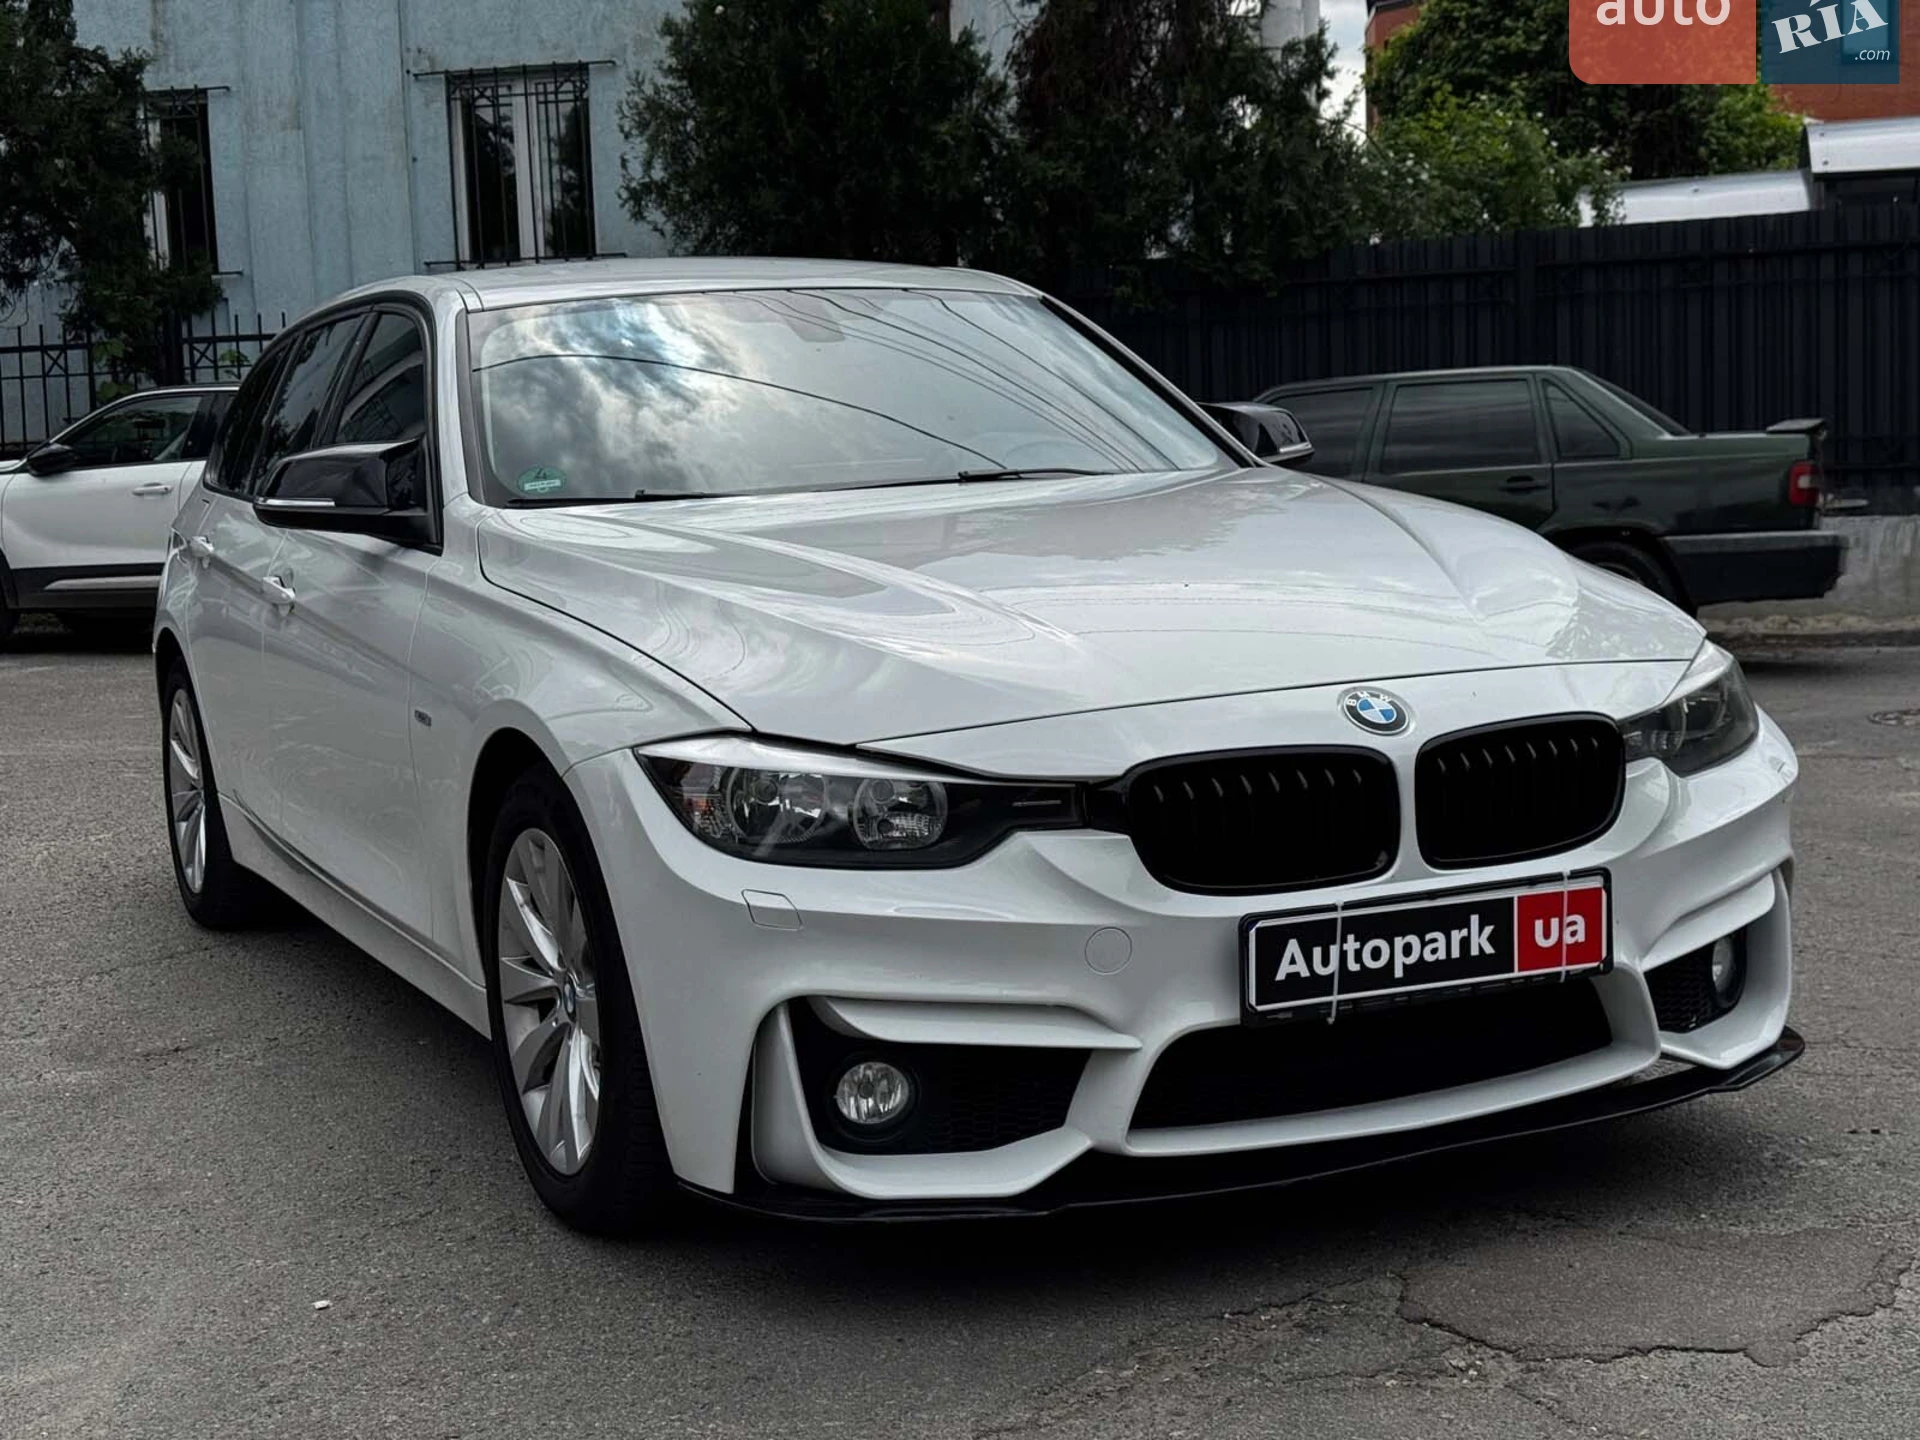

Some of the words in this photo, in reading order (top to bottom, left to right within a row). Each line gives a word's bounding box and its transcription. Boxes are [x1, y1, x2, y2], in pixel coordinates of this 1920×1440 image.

[1345, 690, 1392, 707] BMW
[1274, 914, 1496, 982] Autopark
[1534, 914, 1586, 948] ua
